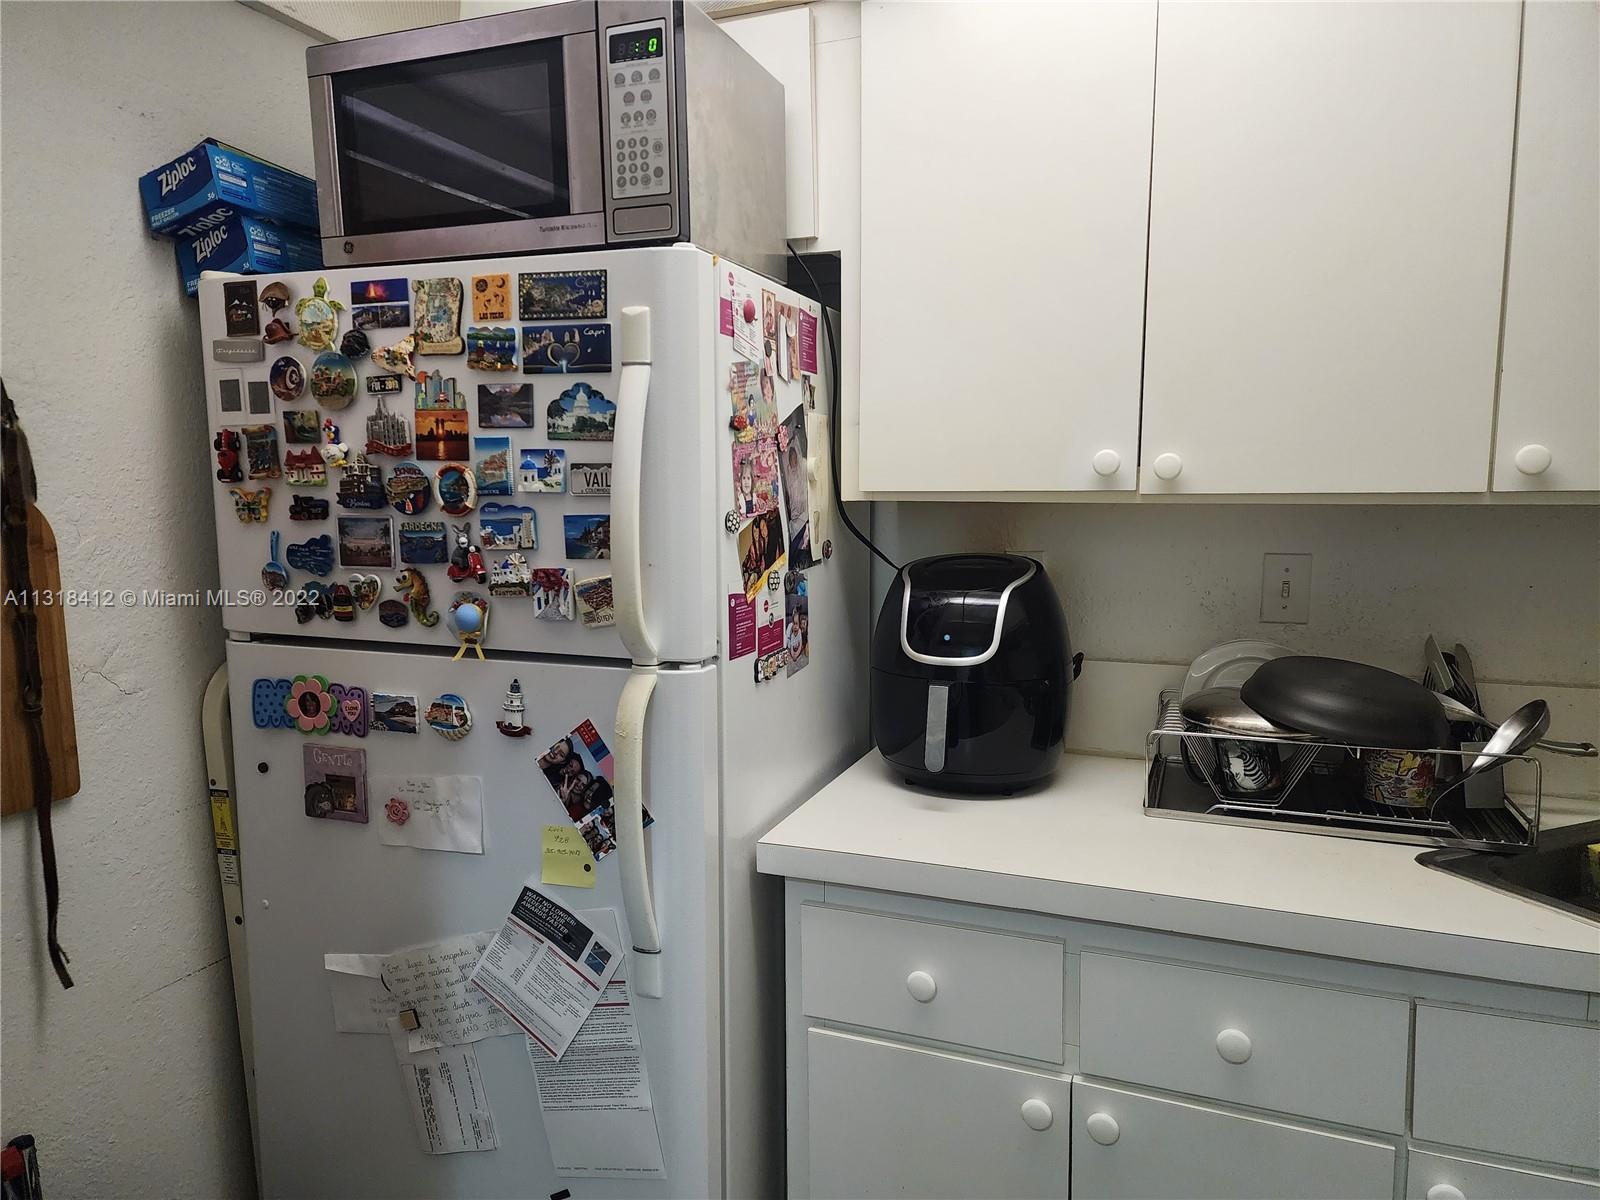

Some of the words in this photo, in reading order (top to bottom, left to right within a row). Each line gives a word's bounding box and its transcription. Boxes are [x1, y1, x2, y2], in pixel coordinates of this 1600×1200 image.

[157, 156, 197, 196] Ziploc
[151, 207, 175, 222] FREEZER
[192, 225, 228, 264] Ziploc
[583, 327, 605, 338] Capri
[584, 472, 612, 488] VAIL
[521, 900, 547, 919] AWARDS
[546, 916, 569, 934] FASTER
[523, 895, 548, 914] REDEEM
[549, 911, 566, 925] YOUR
[526, 890, 543, 902] WAIT
[542, 900, 553, 909] NO
[552, 906, 577, 927] LONGER!
